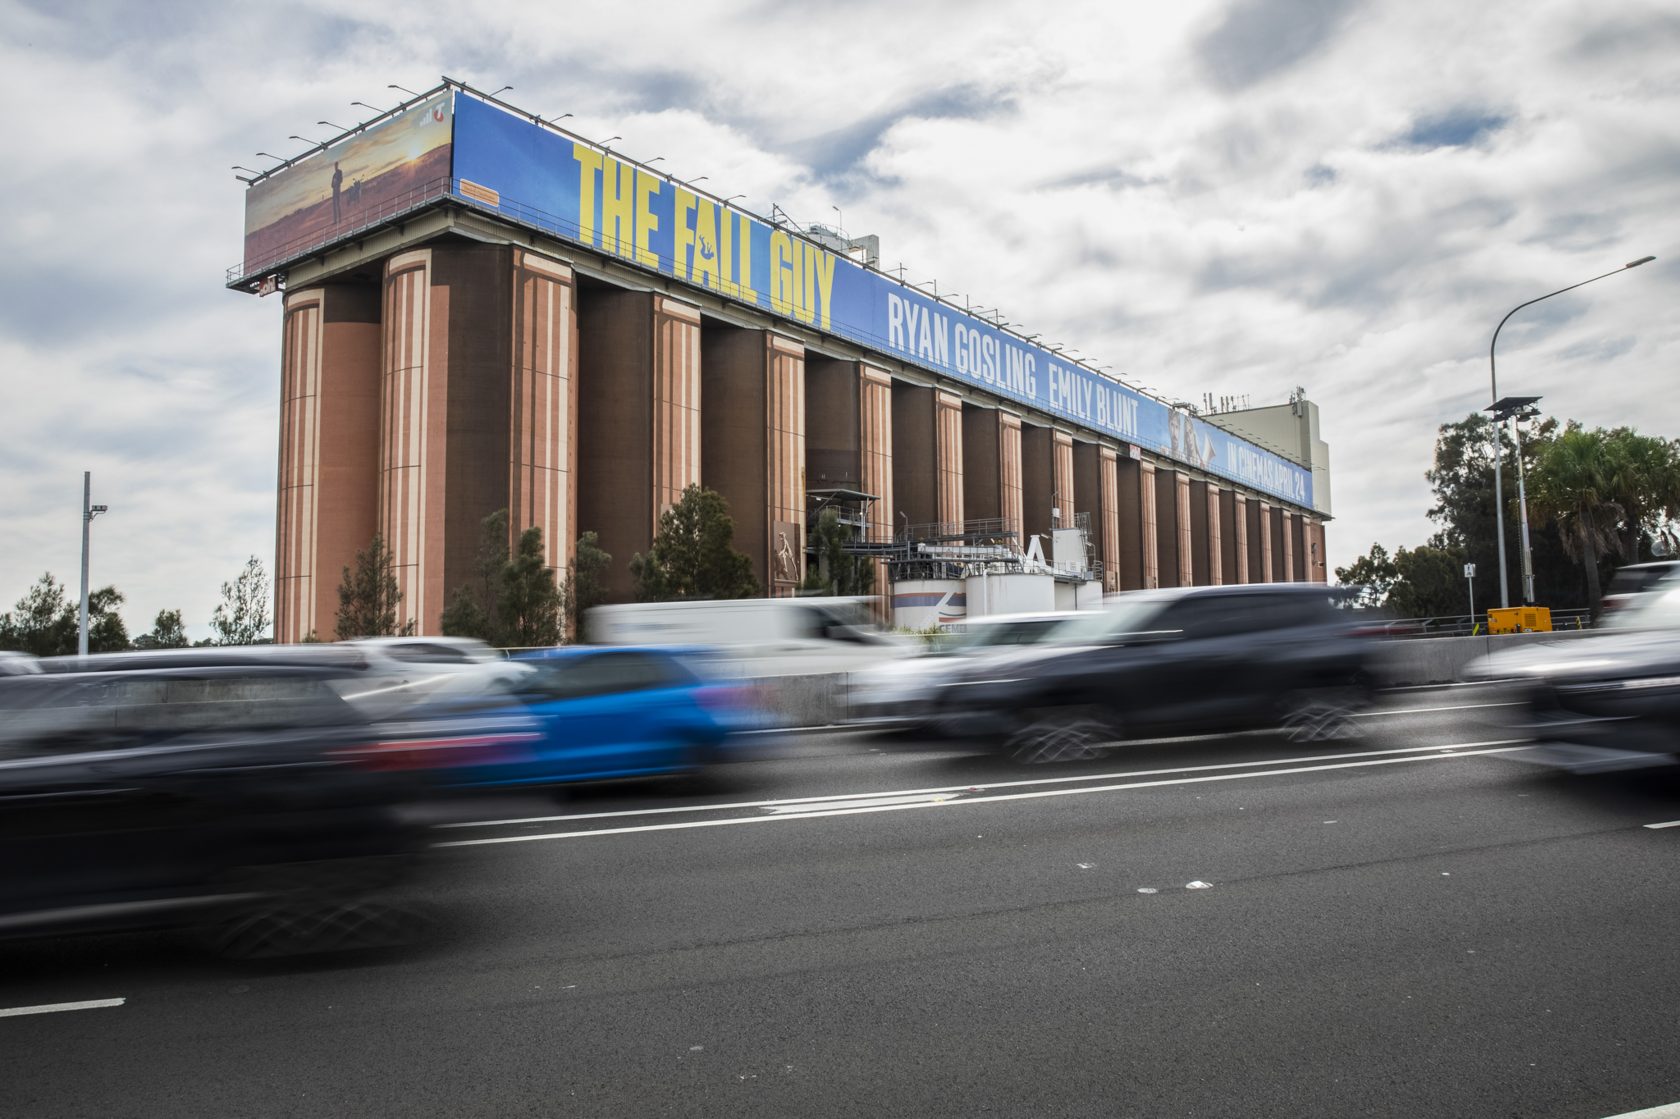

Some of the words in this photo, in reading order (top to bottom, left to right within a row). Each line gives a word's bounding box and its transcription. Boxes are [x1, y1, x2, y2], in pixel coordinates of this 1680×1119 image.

[573, 142, 660, 271] THE
[674, 187, 758, 304] FALL
[770, 231, 836, 331] GUY
[888, 292, 949, 368] RYAN
[954, 323, 1036, 399] GOSLING
[1048, 362, 1092, 421] EMILY
[1096, 384, 1138, 438] BLUNT
[1227, 441, 1237, 473] IN
[1238, 446, 1273, 488] CINEMAS
[1274, 462, 1295, 499] APRIL
[1295, 472, 1305, 502] 24
